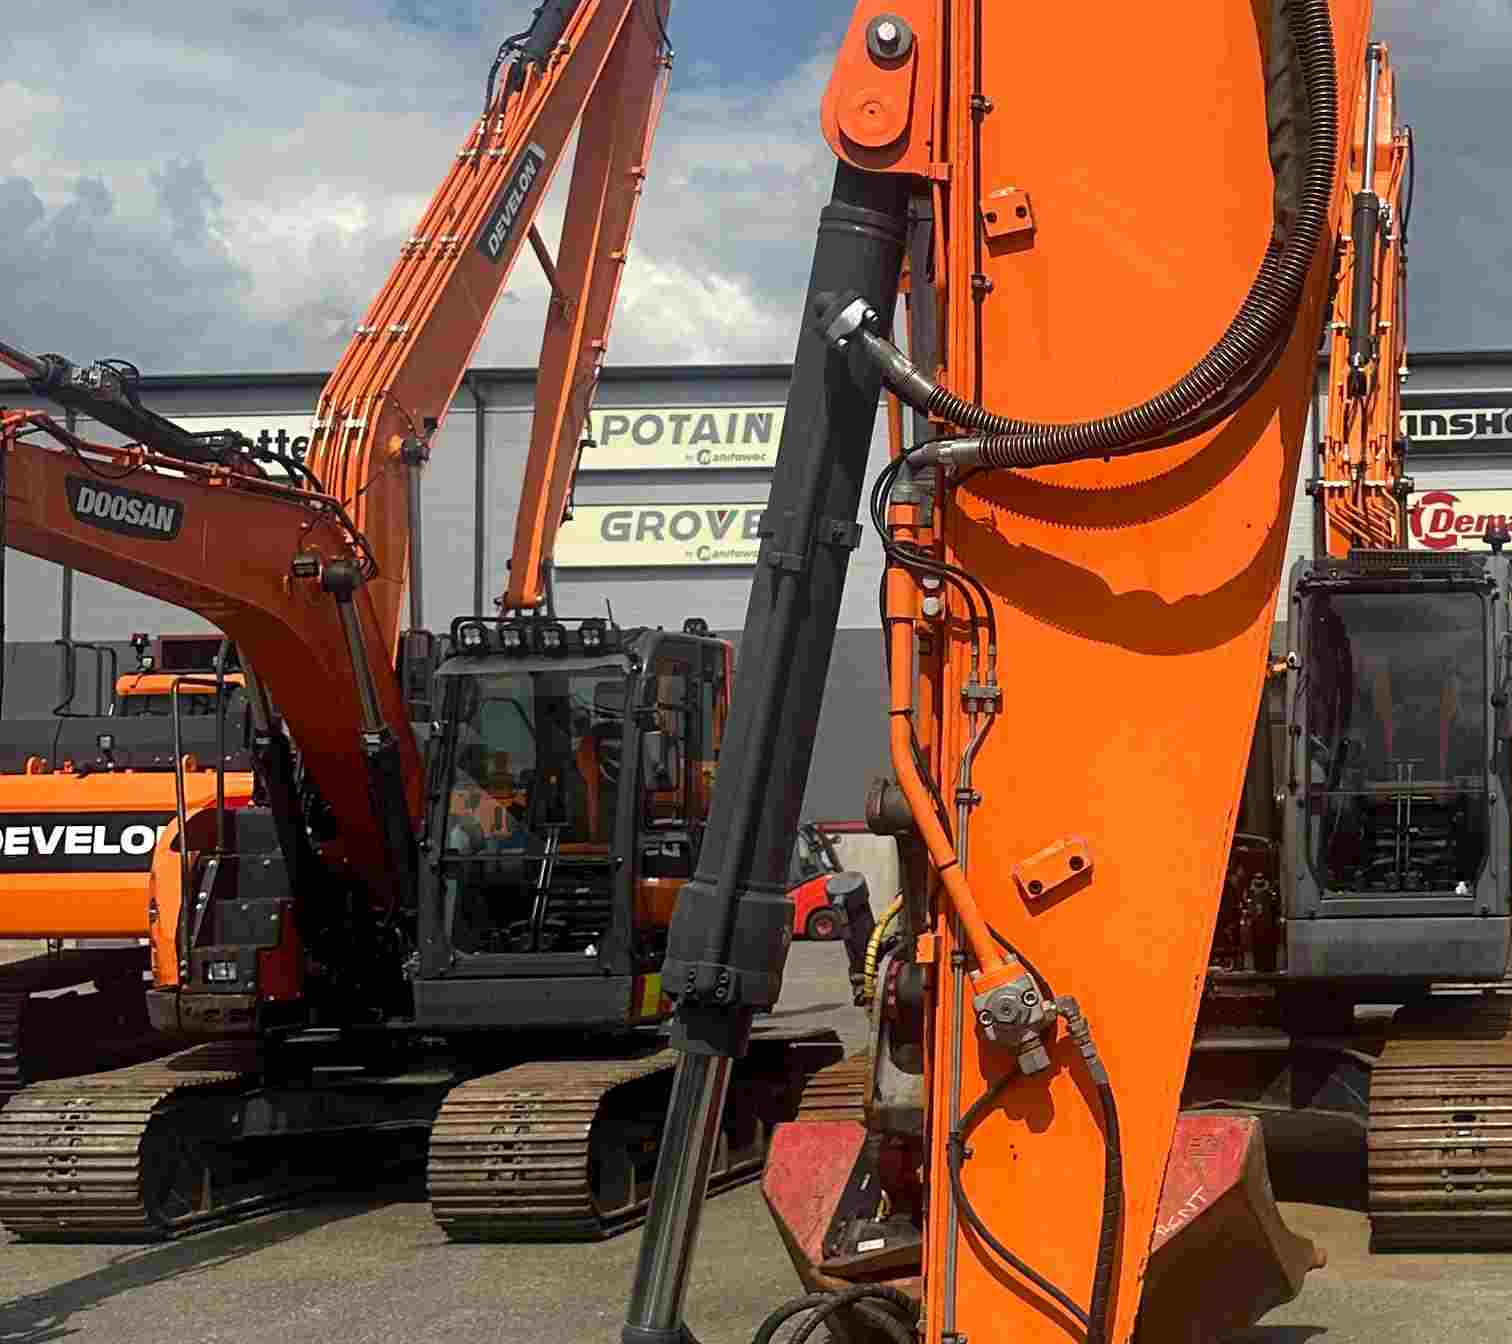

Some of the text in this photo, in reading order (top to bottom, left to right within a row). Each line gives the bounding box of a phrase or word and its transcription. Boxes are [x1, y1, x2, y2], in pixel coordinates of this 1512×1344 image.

[487, 159, 537, 257] DEVELON
[600, 412, 774, 446] POTAIN
[75, 486, 175, 533] DOOSAN
[0, 824, 168, 856] EVELO
